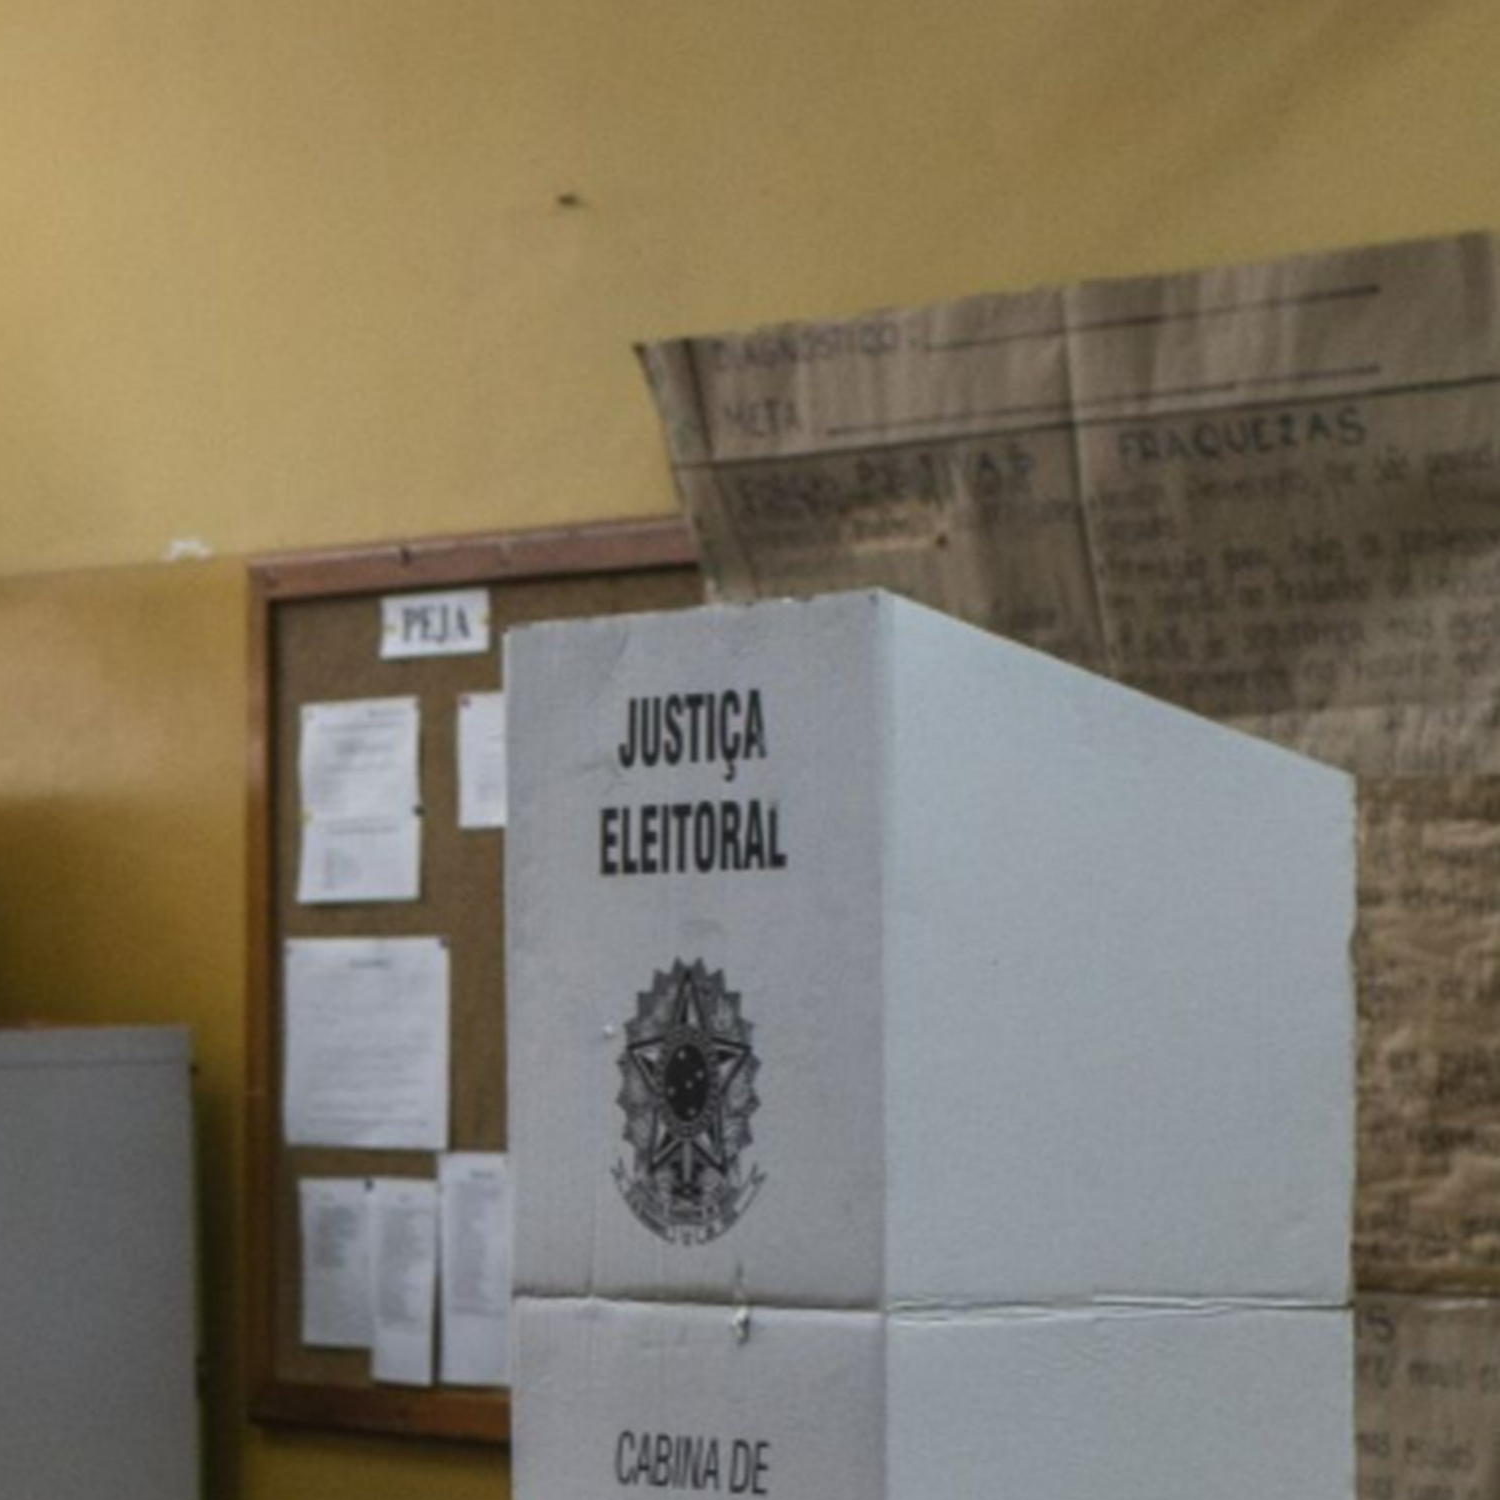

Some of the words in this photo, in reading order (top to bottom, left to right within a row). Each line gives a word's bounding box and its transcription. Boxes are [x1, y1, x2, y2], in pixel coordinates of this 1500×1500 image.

[1118, 405, 1368, 463] FRAQUEZAS
[400, 602, 473, 646] PEJA
[617, 688, 767, 782] JUSTIÇA
[599, 799, 788, 877] ELEITORAL
[614, 1429, 719, 1491] CABINA
[728, 1438, 772, 1496] DE
